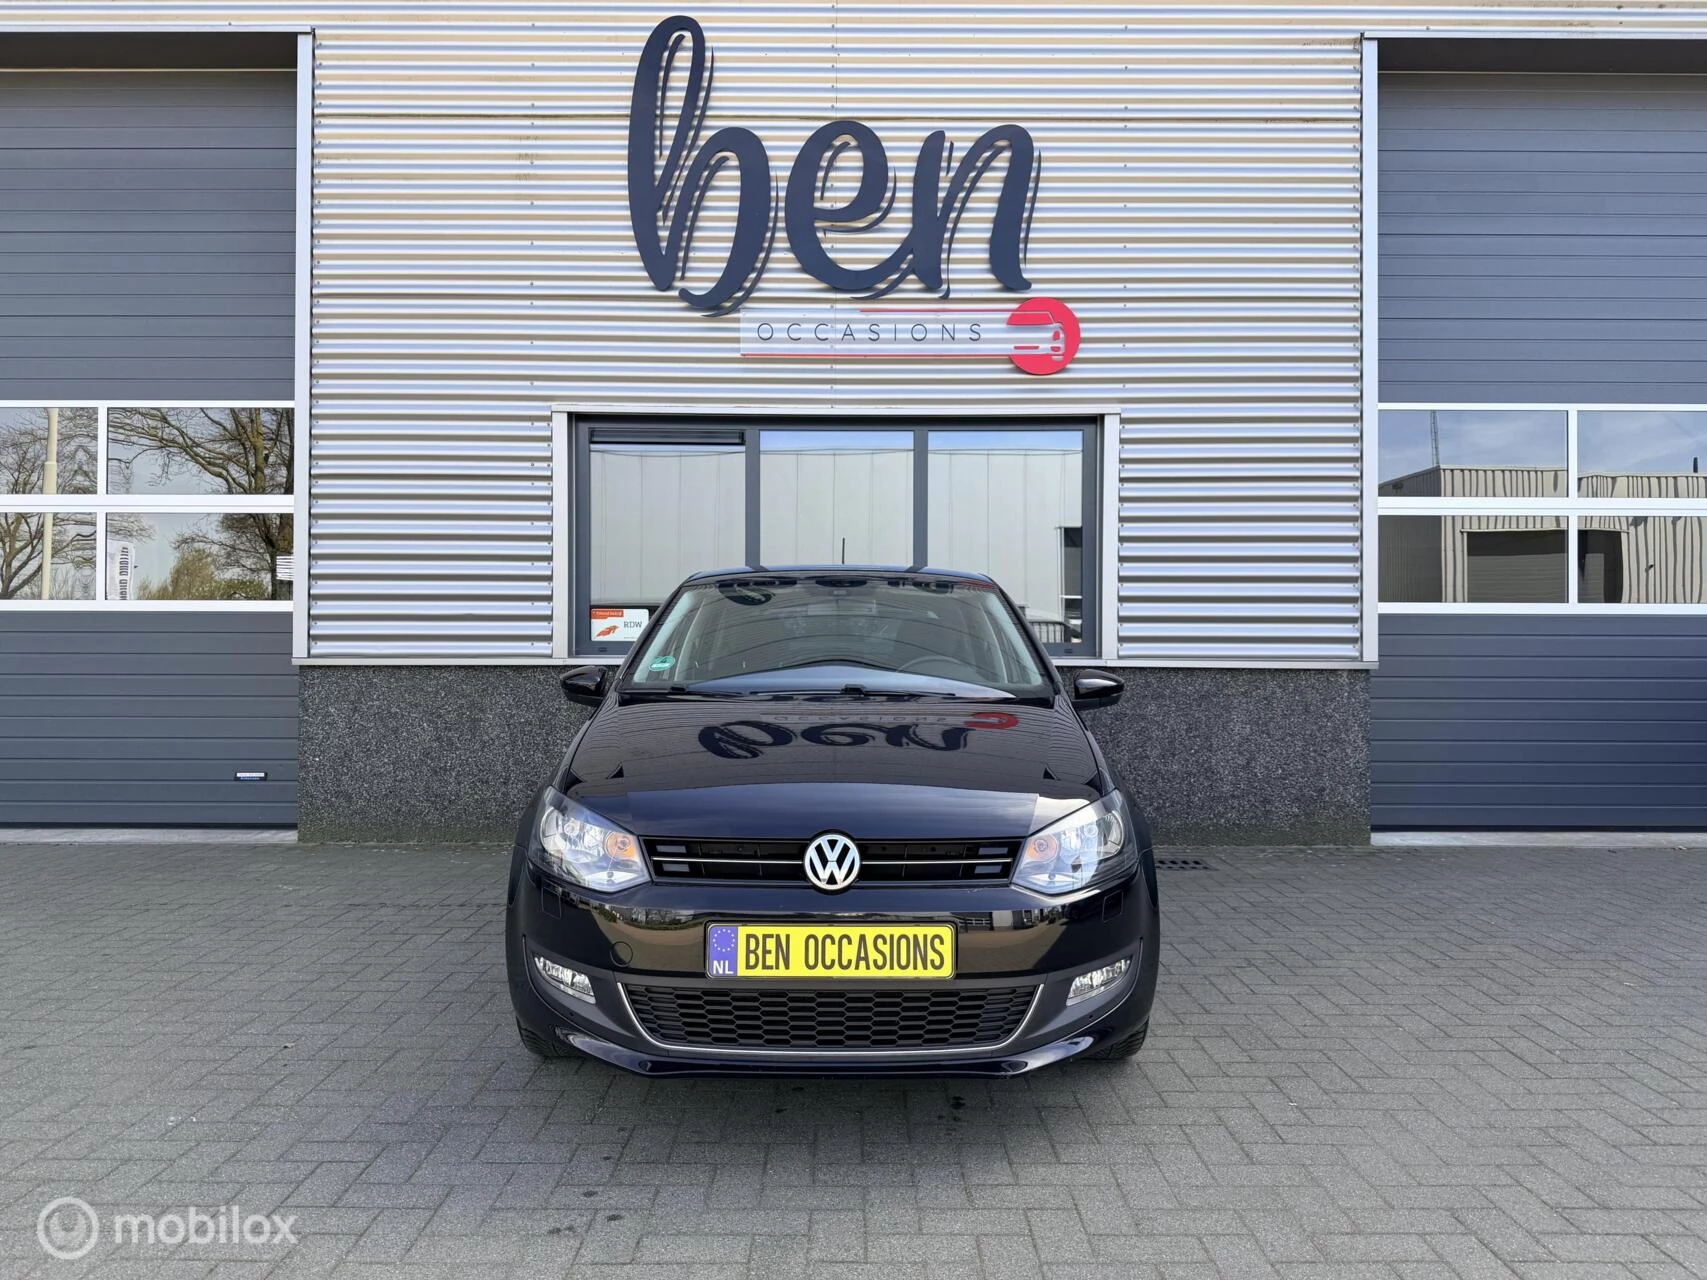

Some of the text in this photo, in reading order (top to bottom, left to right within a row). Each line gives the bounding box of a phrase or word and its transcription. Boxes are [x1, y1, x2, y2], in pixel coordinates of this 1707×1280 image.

[628, 15, 1041, 317] ben
[756, 322, 983, 342] OCCASIONS
[804, 834, 861, 890] VW
[713, 960, 734, 975] NL
[745, 933, 945, 971] BEN OCCASIONS
